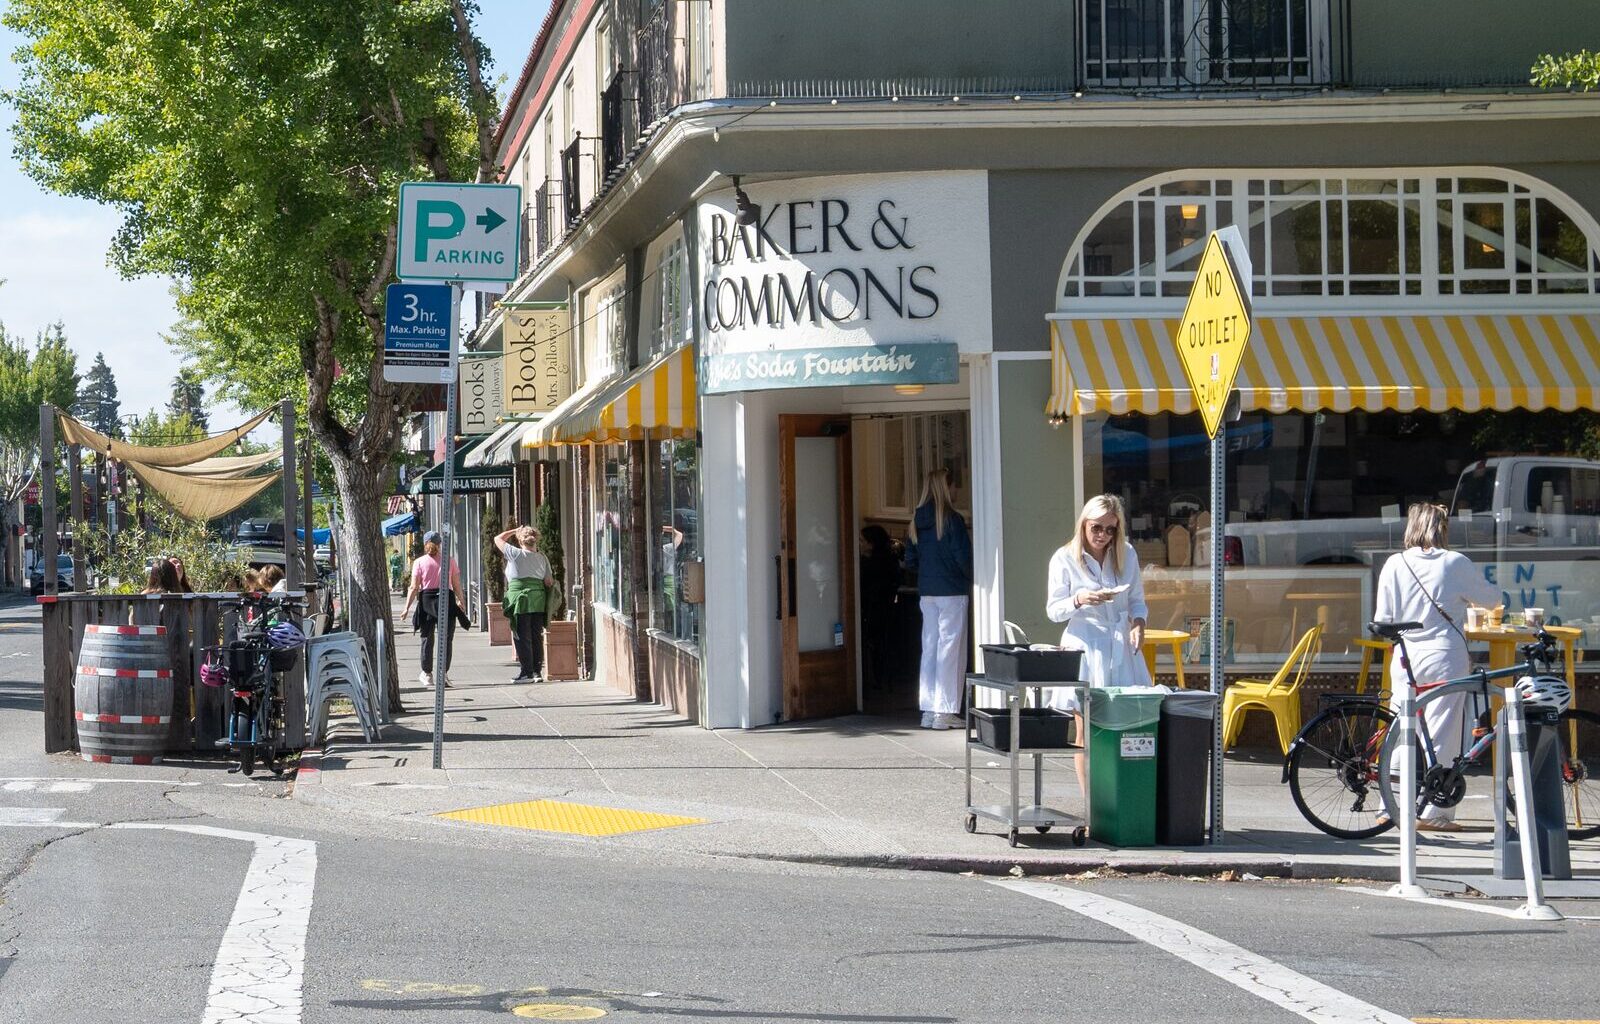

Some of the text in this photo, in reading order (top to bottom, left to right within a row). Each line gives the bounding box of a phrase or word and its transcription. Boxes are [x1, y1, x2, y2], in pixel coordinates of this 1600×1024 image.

[414, 199, 505, 264] PARKING
[711, 199, 916, 265] BAKER &
[704, 265, 939, 332] COMMONS
[1205, 270, 1222, 299] NO
[390, 325, 446, 337] Max. Parking
[395, 341, 440, 349] Premium Rate
[545, 314, 561, 378] Dalloway's
[1189, 315, 1238, 349] OUTLET
[510, 317, 537, 406] Books
[746, 353, 798, 379] Soda
[803, 345, 916, 380] Fountain
[465, 362, 486, 426] Books
[429, 478, 511, 490] SHARI-LA TREASURES
